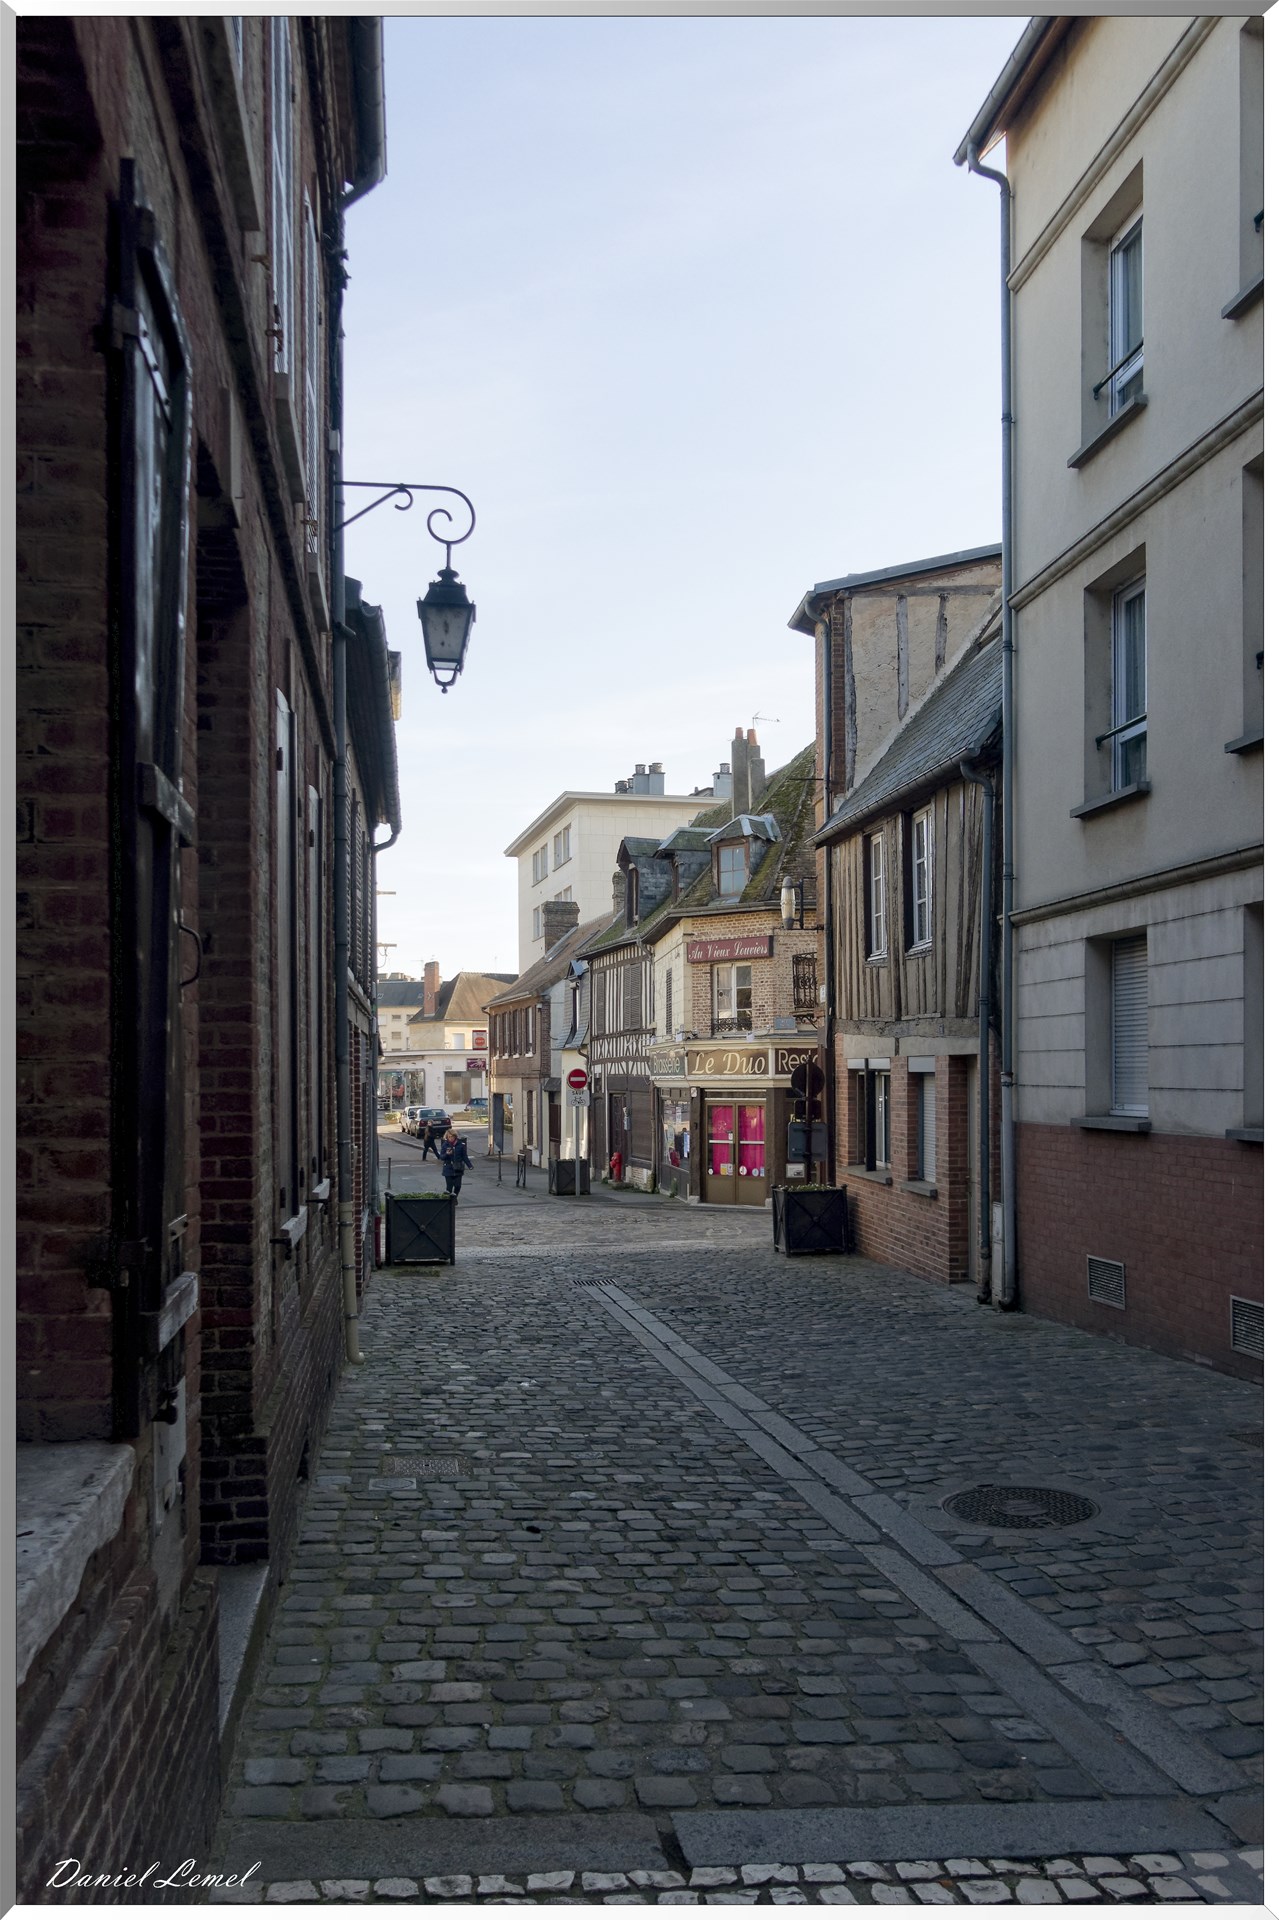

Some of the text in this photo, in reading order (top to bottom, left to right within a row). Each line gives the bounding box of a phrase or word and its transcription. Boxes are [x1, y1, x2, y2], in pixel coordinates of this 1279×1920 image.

[688, 941, 768, 960] Au Vieux Louviers
[653, 1055, 681, 1074] Brasserie
[692, 1052, 766, 1075] Le Duo
